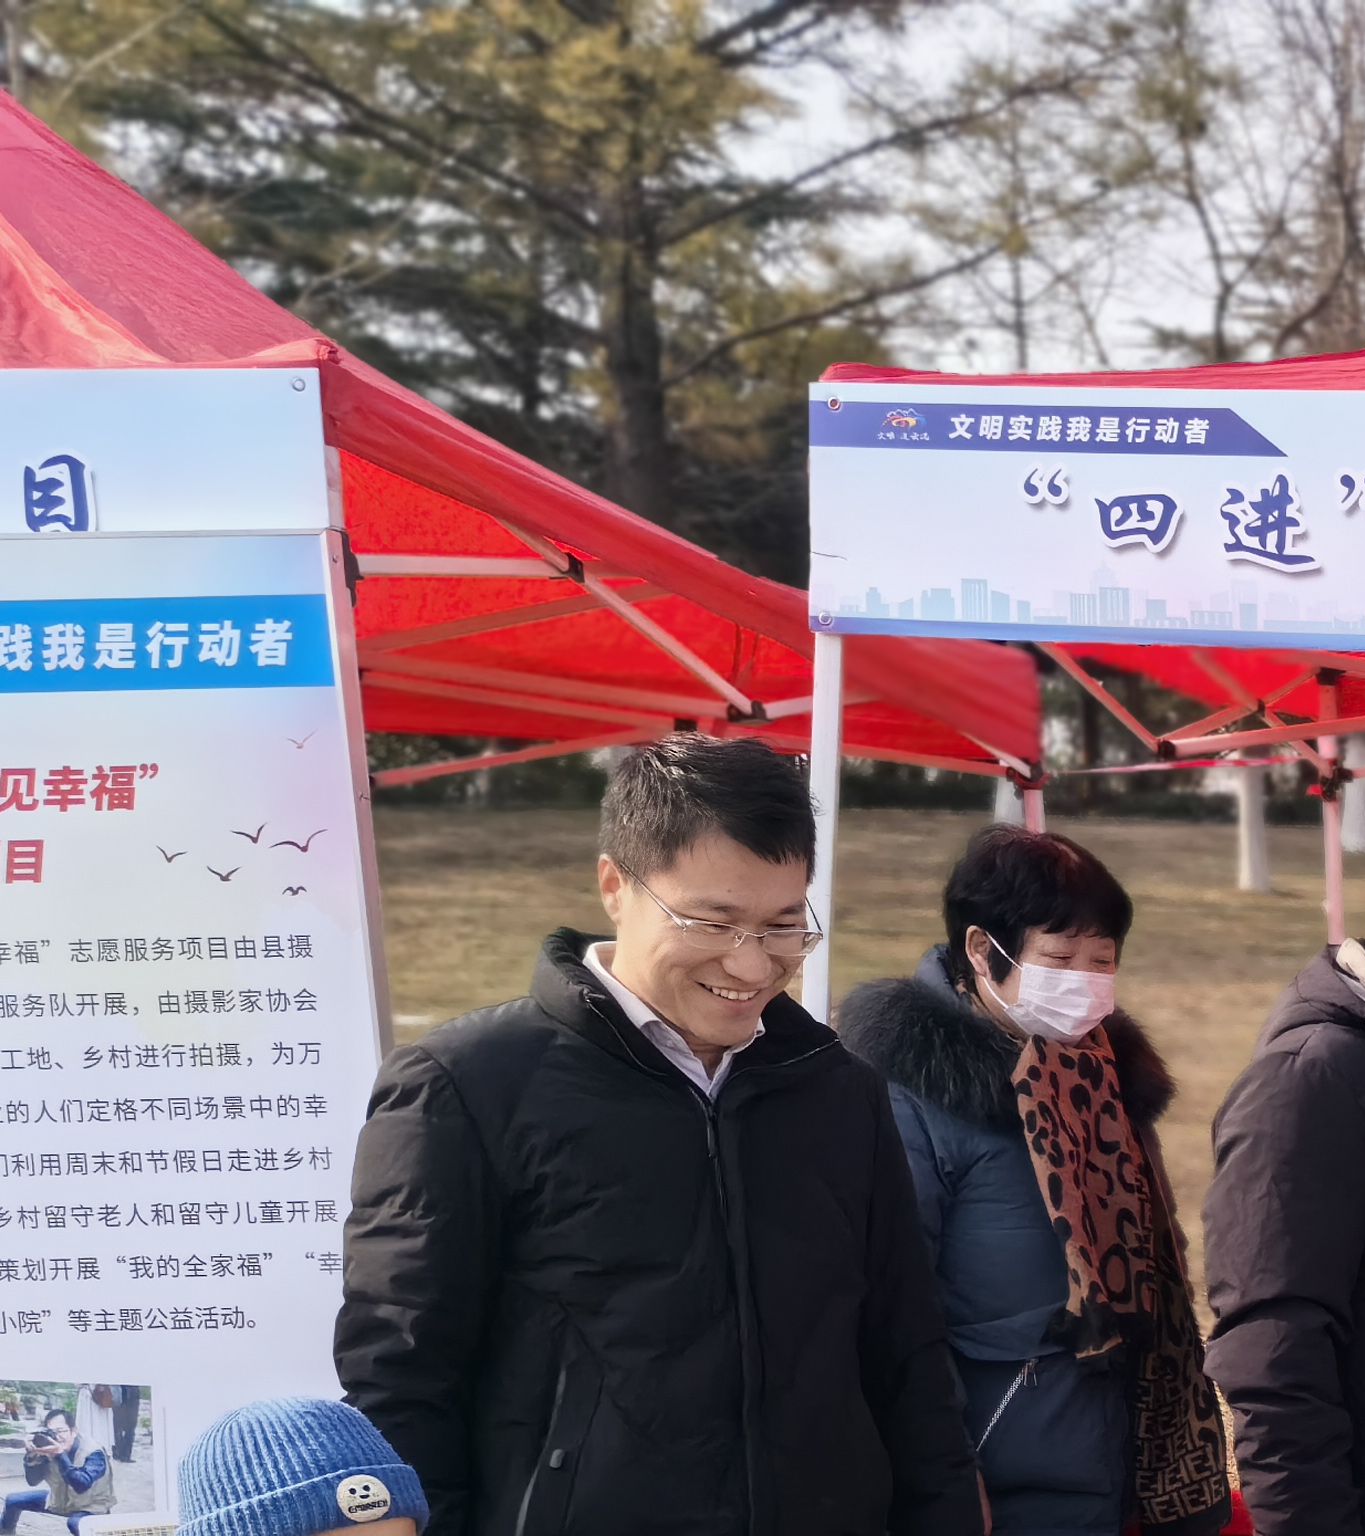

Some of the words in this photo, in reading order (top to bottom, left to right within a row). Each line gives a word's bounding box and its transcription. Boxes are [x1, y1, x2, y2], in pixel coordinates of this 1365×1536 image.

[948, 414, 1210, 444] 文明实践我是行动者
[0, 618, 293, 673] 践我是行动者
[2, 1041, 322, 1071] 工地、乡村进行拍摄，为万
[0, 1094, 327, 1124] 的人们定格不同场景中的幸
